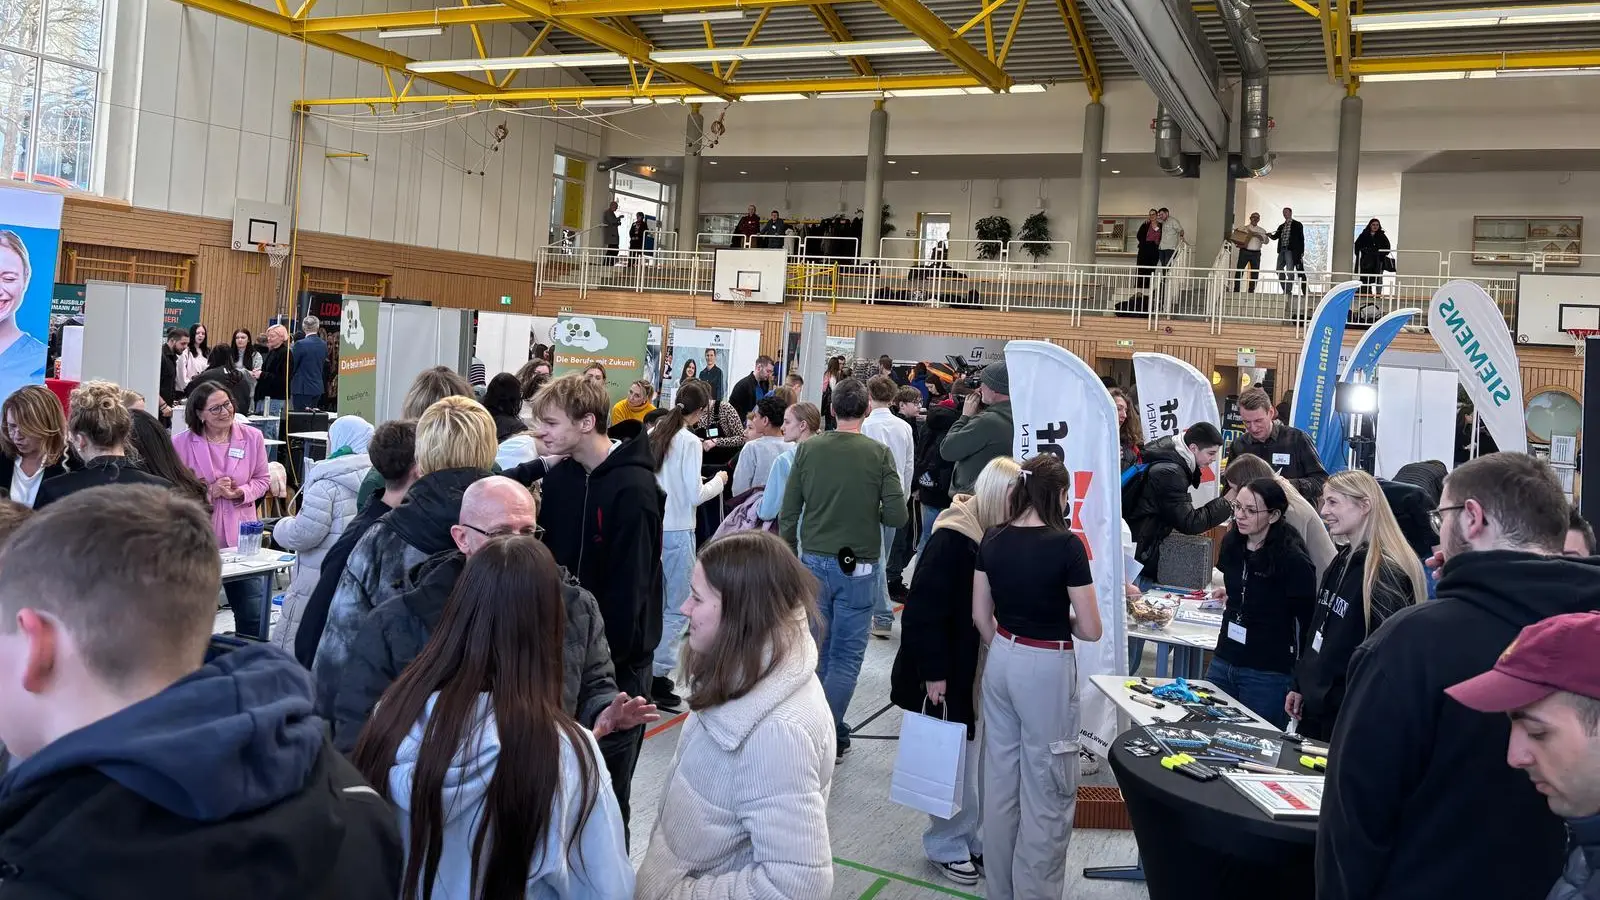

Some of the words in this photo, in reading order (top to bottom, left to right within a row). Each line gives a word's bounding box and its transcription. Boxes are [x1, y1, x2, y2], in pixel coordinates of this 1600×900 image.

[164, 307, 184, 315] UNFT
[971, 350, 982, 358] LH
[609, 359, 636, 367] Zukunft
